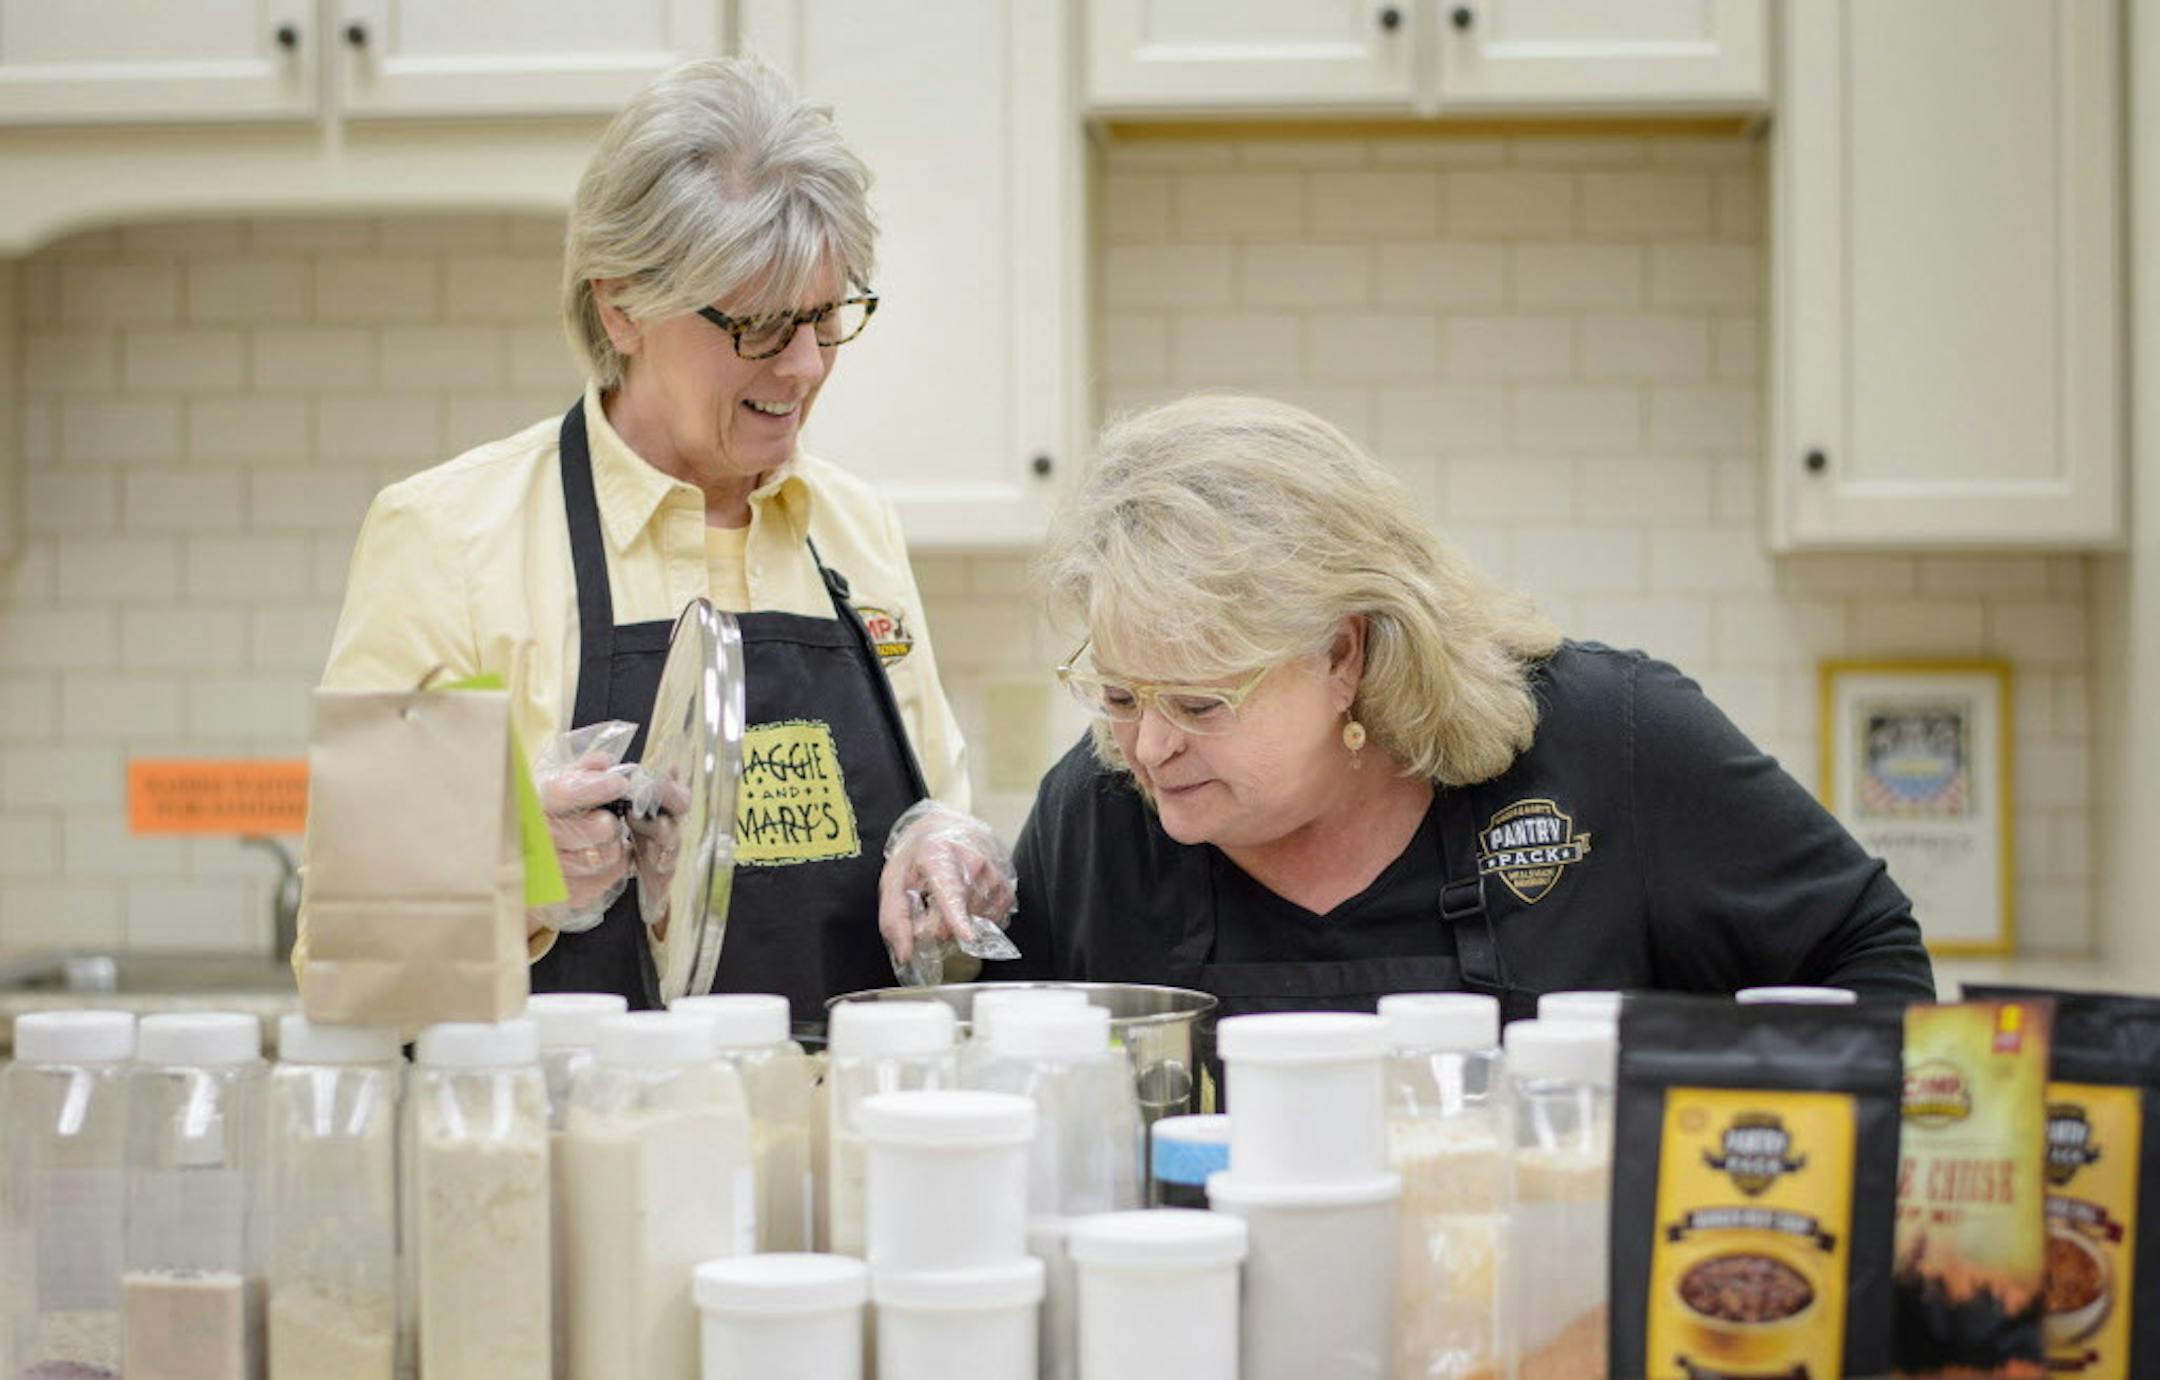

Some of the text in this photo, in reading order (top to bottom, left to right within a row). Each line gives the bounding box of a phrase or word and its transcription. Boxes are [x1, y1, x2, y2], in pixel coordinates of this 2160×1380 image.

[762, 786, 800, 799] AND
[1490, 817, 1560, 850] PANTRY
[1498, 847, 1559, 867] PACK
